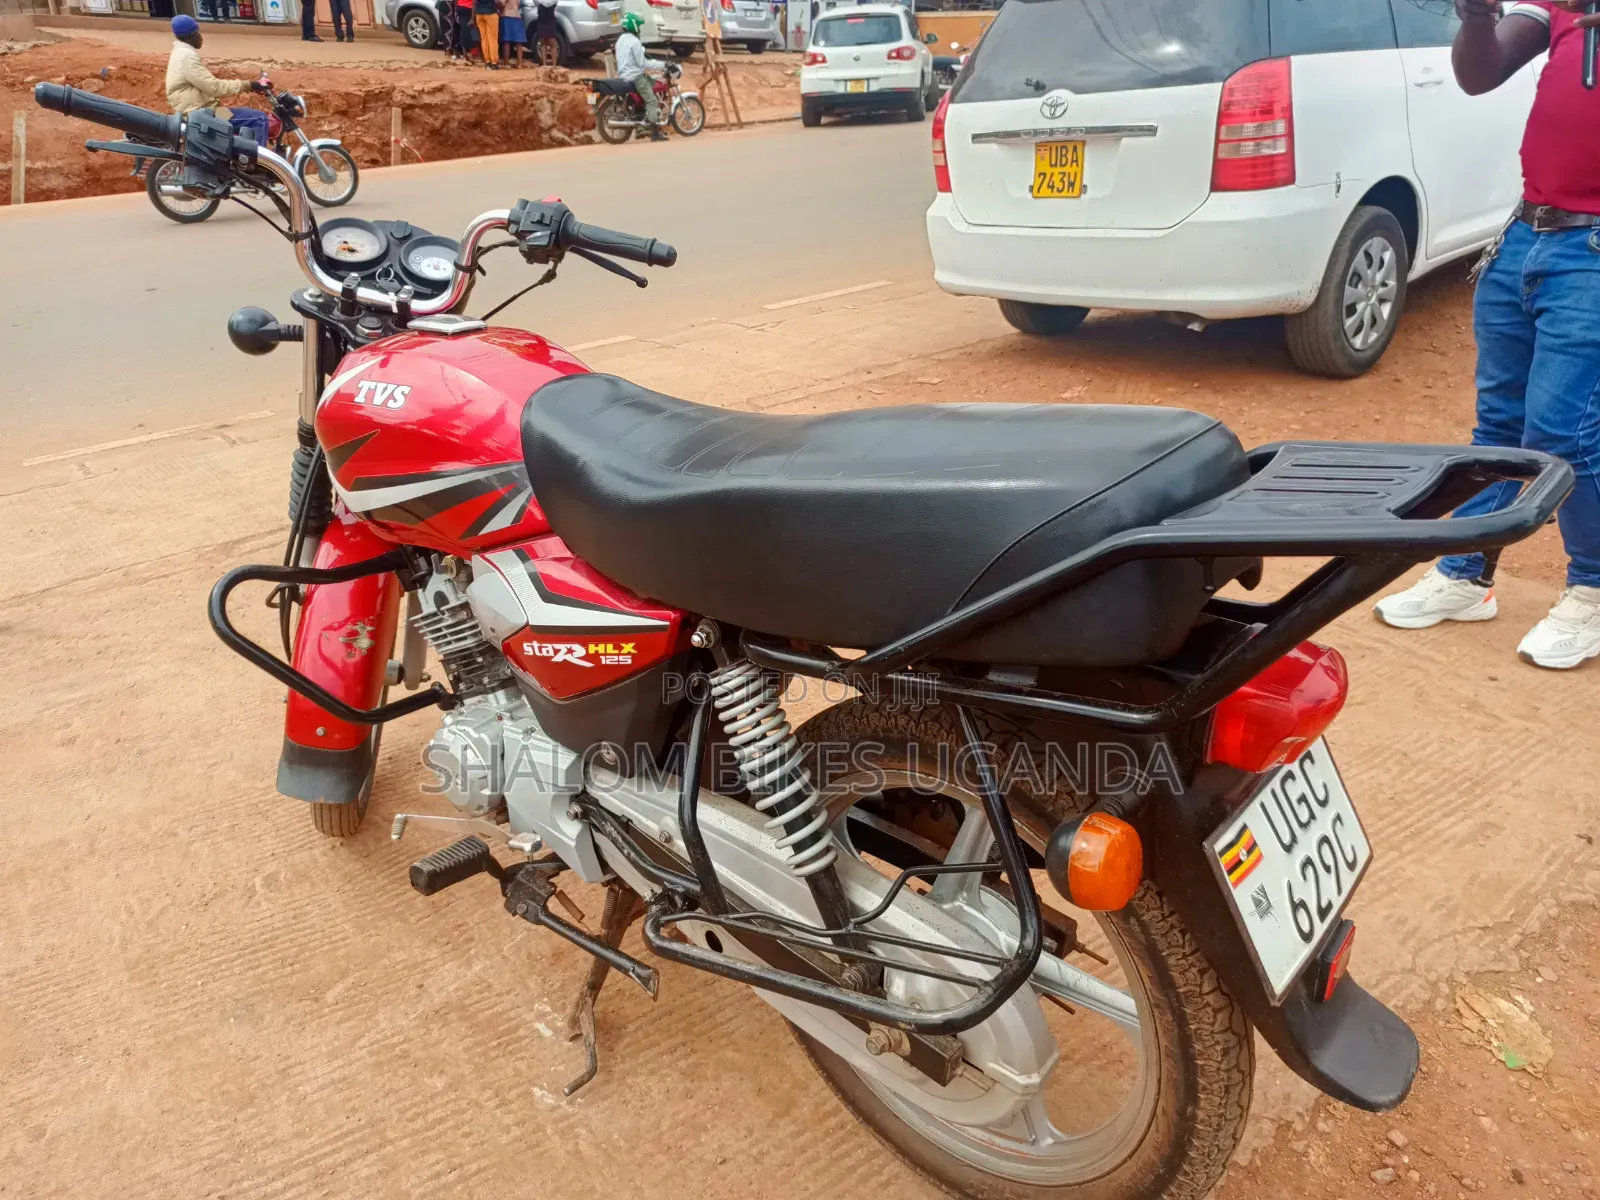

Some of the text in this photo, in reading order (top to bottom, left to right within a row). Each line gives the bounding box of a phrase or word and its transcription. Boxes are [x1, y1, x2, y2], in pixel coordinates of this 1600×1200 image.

[1049, 145, 1079, 168] UBA
[1037, 172, 1078, 194] 743W
[353, 380, 412, 409] TVS
[588, 642, 638, 654] HLX
[600, 655, 632, 665] 125
[1259, 749, 1330, 855] UGC
[1286, 810, 1358, 944] 629C
